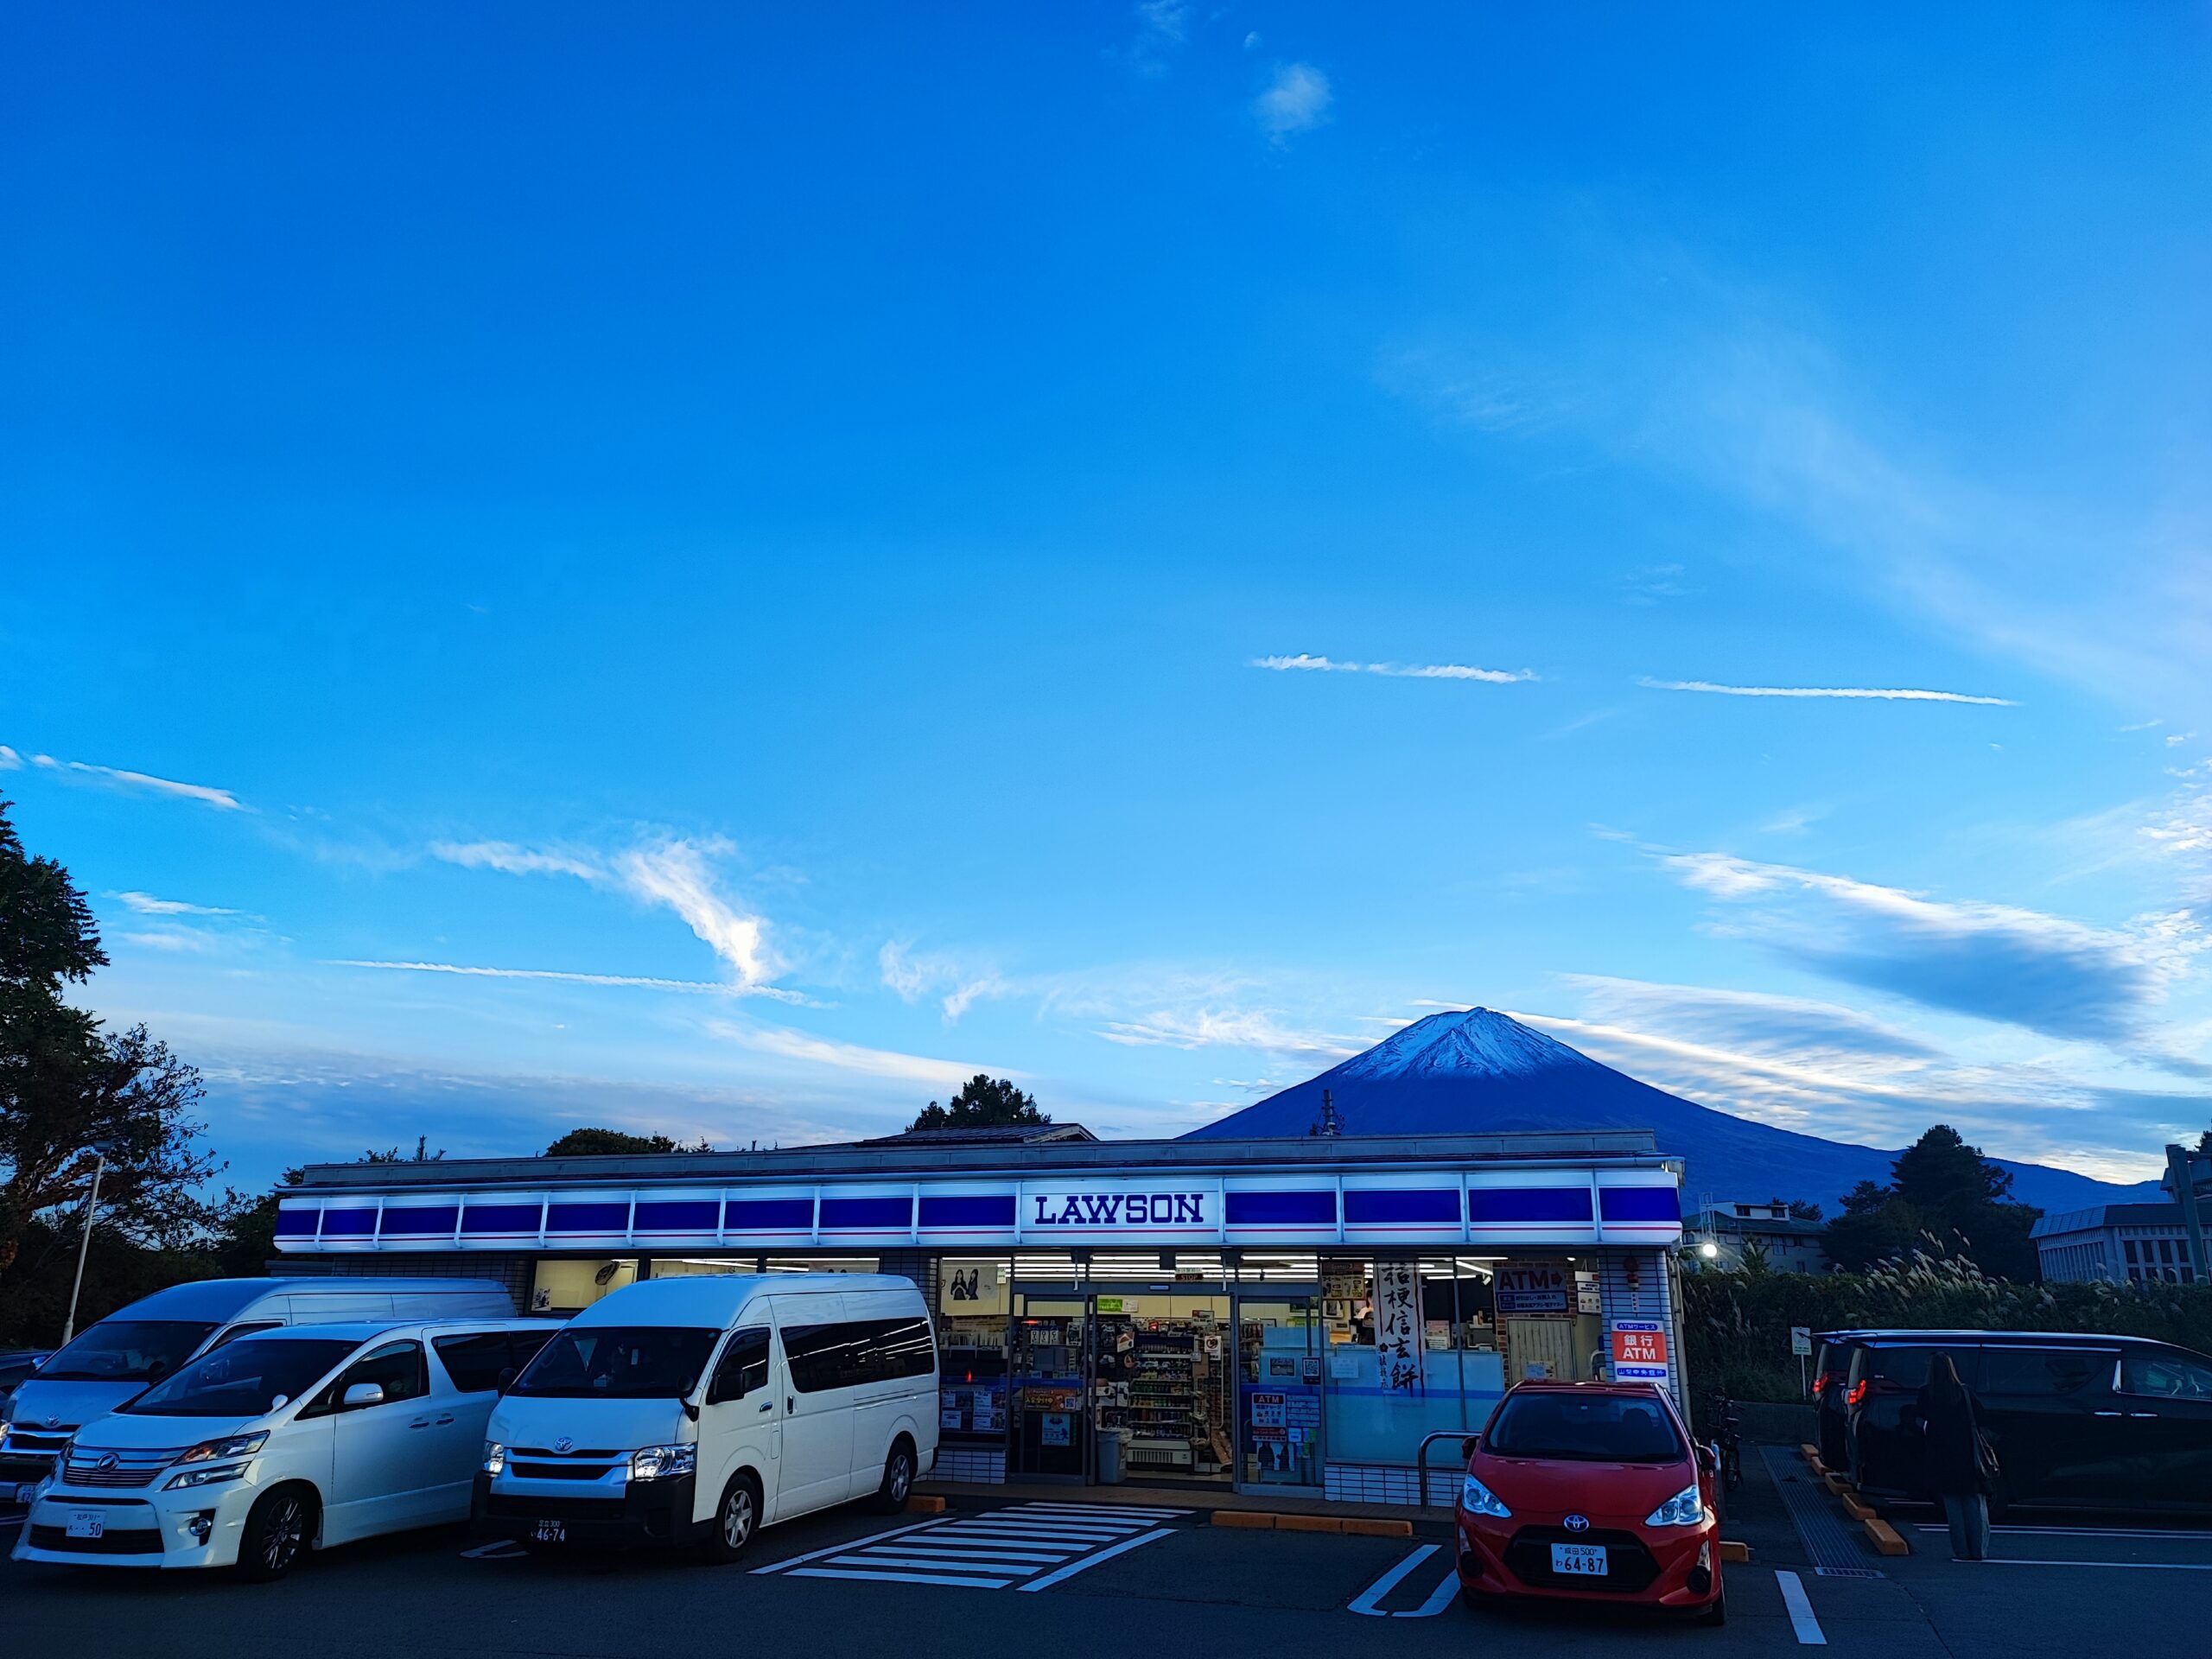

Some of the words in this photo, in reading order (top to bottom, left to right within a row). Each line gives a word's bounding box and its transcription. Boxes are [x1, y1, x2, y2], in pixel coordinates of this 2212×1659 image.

[1034, 1193, 1205, 1224] LAWSON
[1499, 1270, 1549, 1290] ATM
[1624, 1334, 1654, 1347] 銀行
[1622, 1347, 1656, 1360] ATM
[1257, 1395, 1280, 1403] ATM
[89, 1522, 102, 1536] 50
[537, 1528, 565, 1541] 46-74
[1564, 1556, 1605, 1573] 64-87
